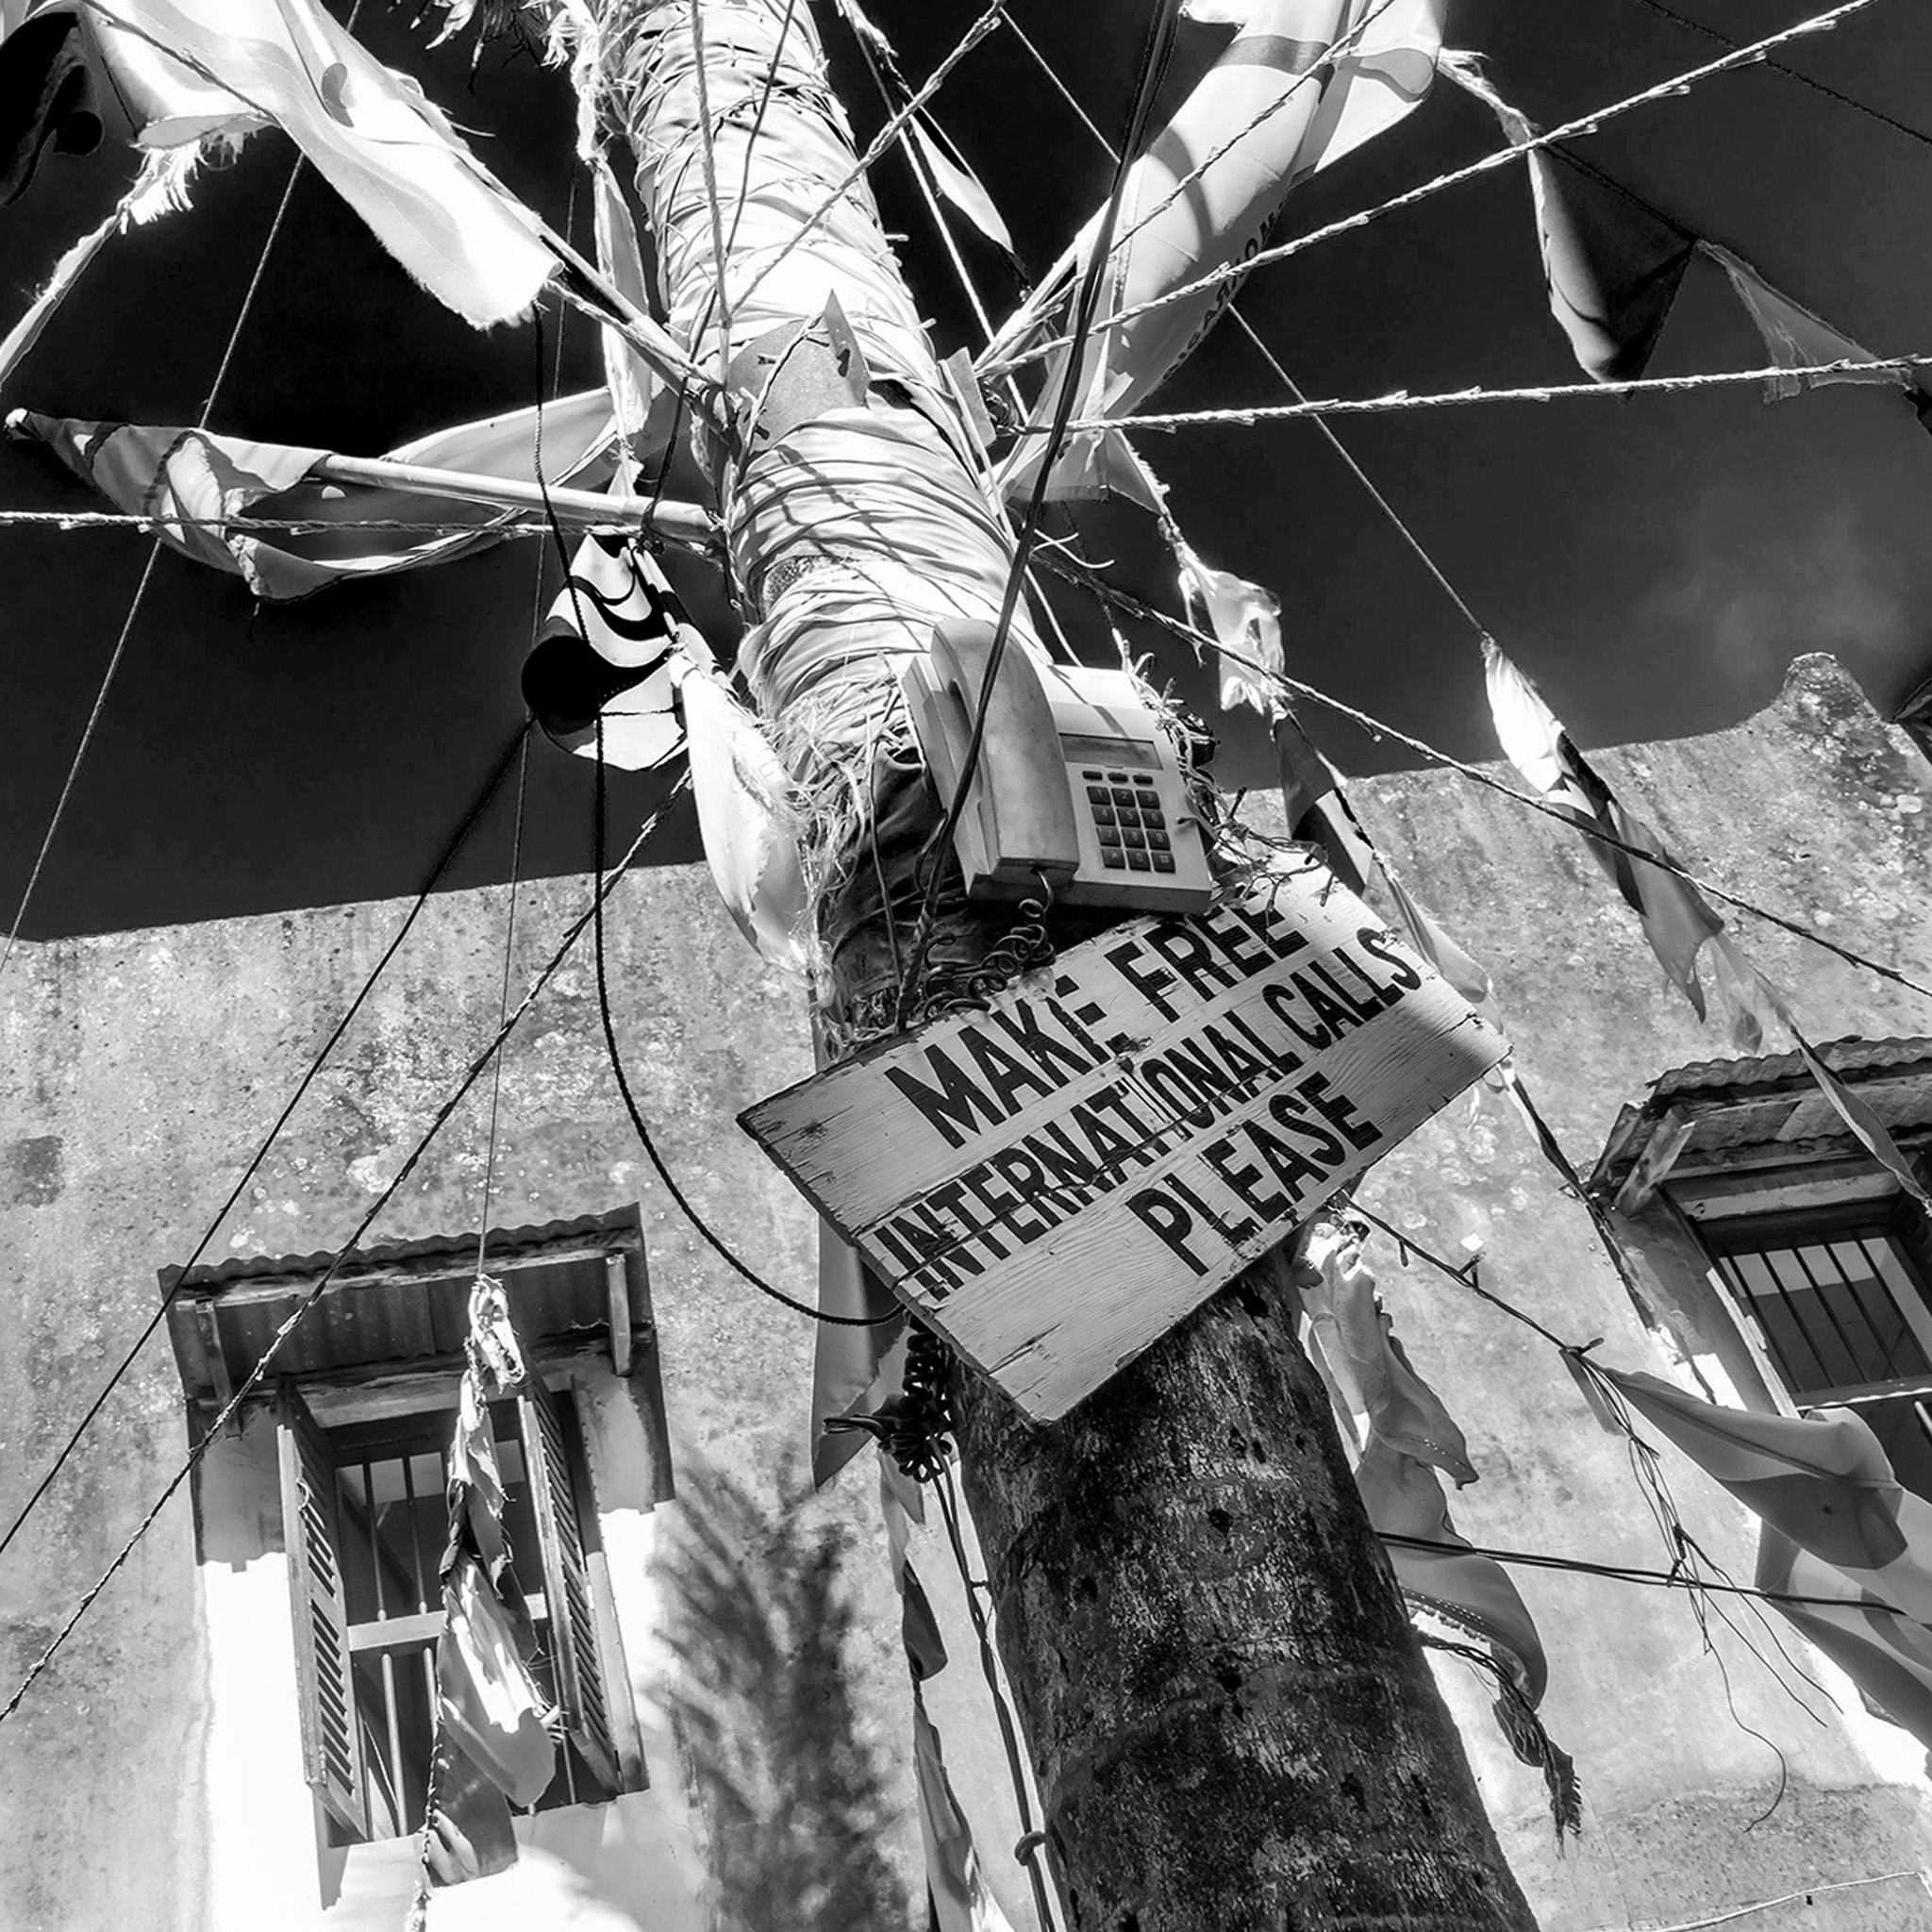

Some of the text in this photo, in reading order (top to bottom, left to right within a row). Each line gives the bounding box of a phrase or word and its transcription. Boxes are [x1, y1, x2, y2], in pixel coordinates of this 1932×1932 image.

[874, 926, 1422, 1303] INTERNATIONAL CALLS
[884, 884, 1309, 1149] MAKE FREE
[1126, 1072, 1383, 1276] PLEASE
